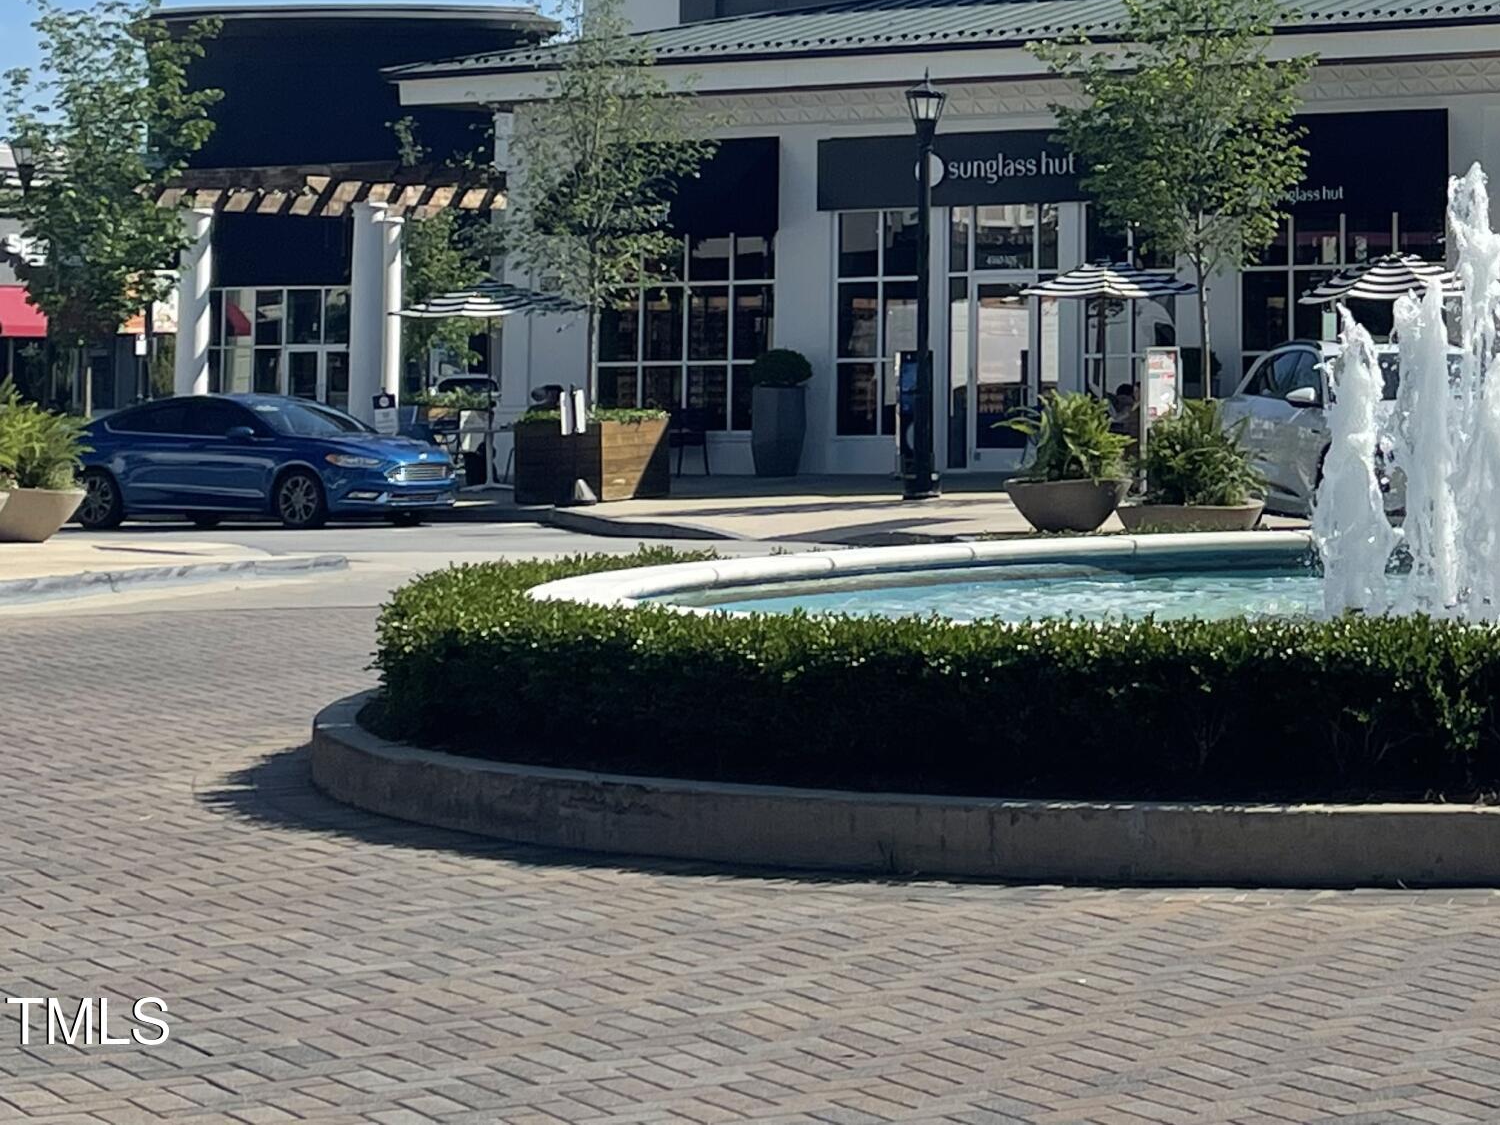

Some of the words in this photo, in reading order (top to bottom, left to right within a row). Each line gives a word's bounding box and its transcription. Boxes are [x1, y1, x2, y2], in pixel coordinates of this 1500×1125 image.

[948, 152, 1038, 184] sunglass
[1041, 150, 1076, 175] hut
[1322, 185, 1344, 200] hut
